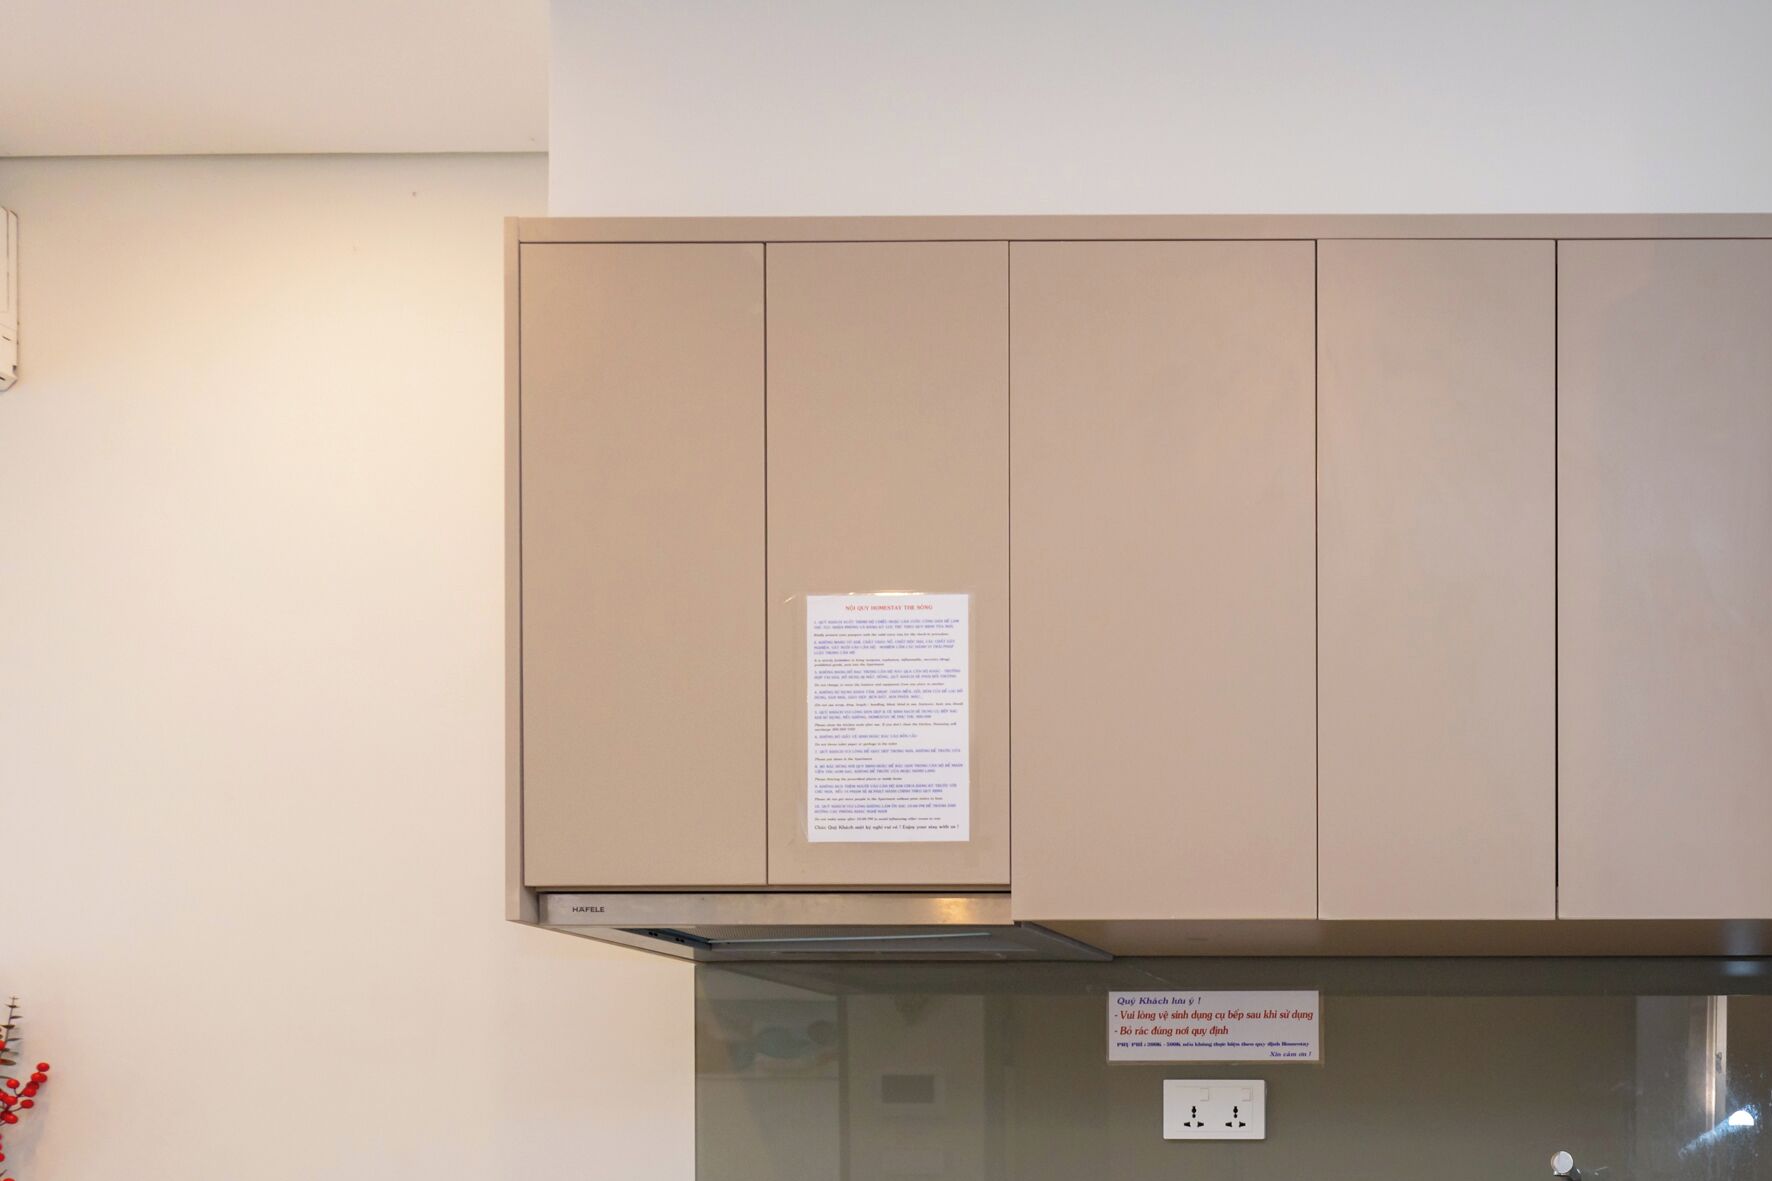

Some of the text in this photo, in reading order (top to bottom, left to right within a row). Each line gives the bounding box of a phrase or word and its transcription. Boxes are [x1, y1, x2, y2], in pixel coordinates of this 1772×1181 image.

[1117, 997, 1135, 1006] Quý
[1139, 997, 1169, 1006] Khách
[1171, 997, 1186, 1006] lưu
[1198, 997, 1201, 1006] !
[1120, 1010, 1135, 1019] Vui
[1137, 1010, 1156, 1021] lòng
[1158, 1011, 1168, 1020] vệ
[1171, 1010, 1188, 1019] sinh
[1191, 1010, 1213, 1021] dụng
[1215, 1012, 1225, 1021] cụ
[1228, 1009, 1244, 1021] bếp
[1263, 1010, 1277, 1019] khi
[1280, 1009, 1290, 1019] sử
[1291, 1010, 1314, 1021] dụng
[1135, 1026, 1148, 1035] rác
[1151, 1026, 1173, 1037] đúng
[1175, 1026, 1189, 1035] nơi
[1191, 1028, 1207, 1037] quy
[1209, 1026, 1228, 1036] định
